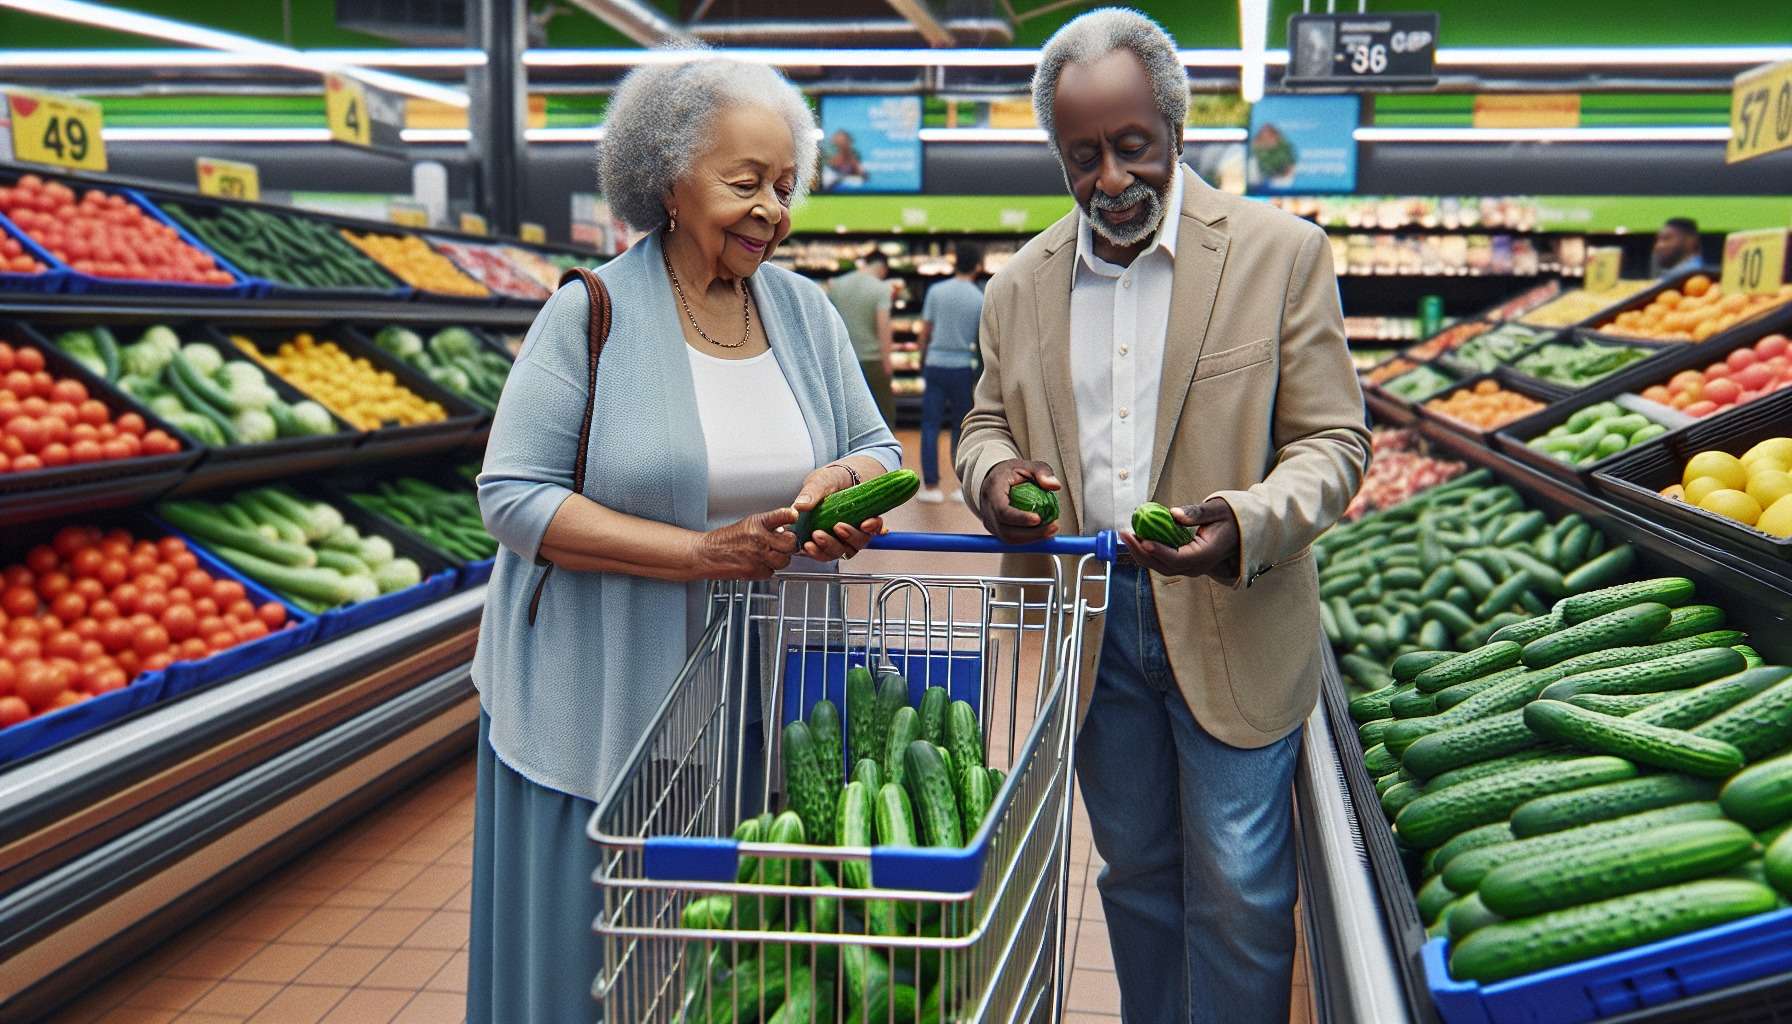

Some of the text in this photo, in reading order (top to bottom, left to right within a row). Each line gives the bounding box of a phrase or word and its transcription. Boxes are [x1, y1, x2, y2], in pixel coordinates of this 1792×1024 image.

[43, 116, 88, 161] 49
[345, 98, 359, 135] 4
[1738, 88, 1769, 151] 57
